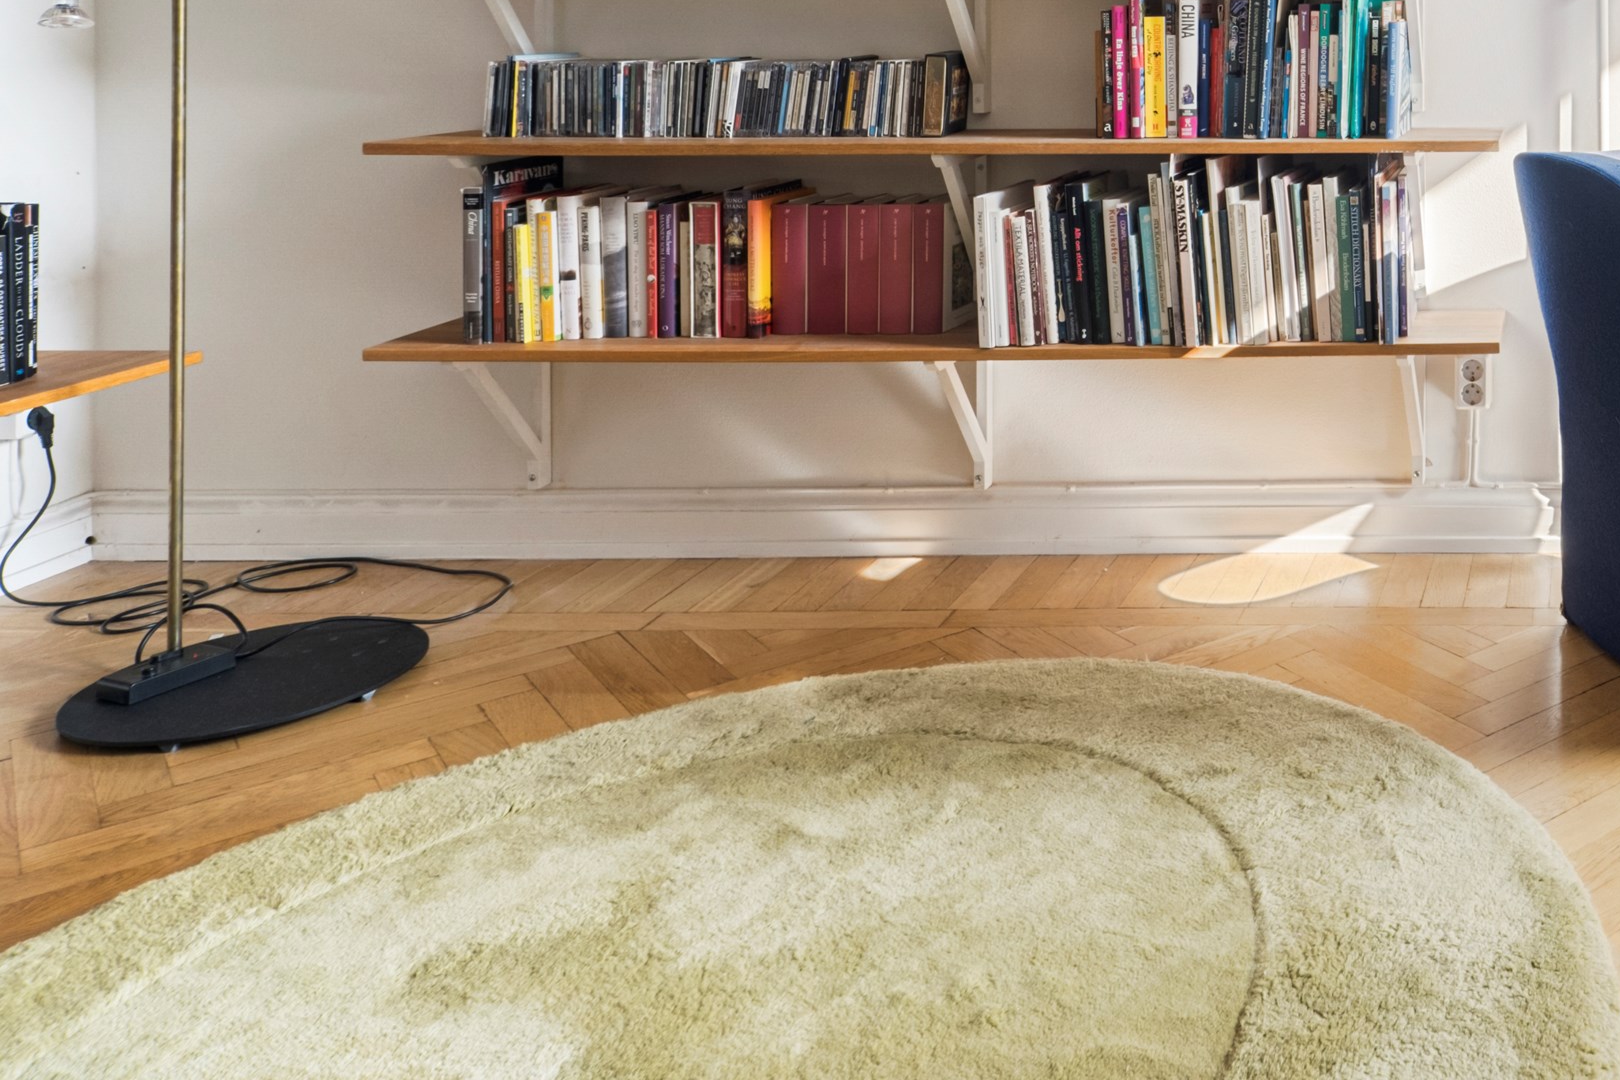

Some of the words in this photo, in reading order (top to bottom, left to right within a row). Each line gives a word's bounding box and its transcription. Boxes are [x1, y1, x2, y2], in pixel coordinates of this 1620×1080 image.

[1180, 4, 1196, 39] CHINA
[1115, 38, 1123, 49] En
[1153, 23, 1161, 57] COUNTR
[1167, 37, 1175, 65] BEIJING
[1237, 12, 1247, 64] SCOTLAND
[1114, 51, 1124, 70] linje
[1153, 57, 1162, 82] DRIVING
[1115, 71, 1124, 90] över
[1299, 65, 1307, 92] REGIONS
[1319, 74, 1327, 96] BERRY
[1299, 93, 1306, 101] OF
[1319, 96, 1327, 130] LIMOUSIN
[467, 211, 477, 235] China
[1073, 227, 1082, 240] Allt
[1350, 207, 1359, 236] STITCH
[1014, 225, 1023, 258] TEXTILA
[1074, 241, 1082, 252] om
[1108, 209, 1119, 265] Kulturkoftor
[14, 236, 24, 286] LADDER
[1075, 252, 1084, 282] stickning
[1352, 237, 1362, 289] DICTIONARY
[1016, 258, 1026, 297] MATERIAL
[1123, 275, 1131, 292] SKILLS
[15, 308, 24, 359] CLOUDS
